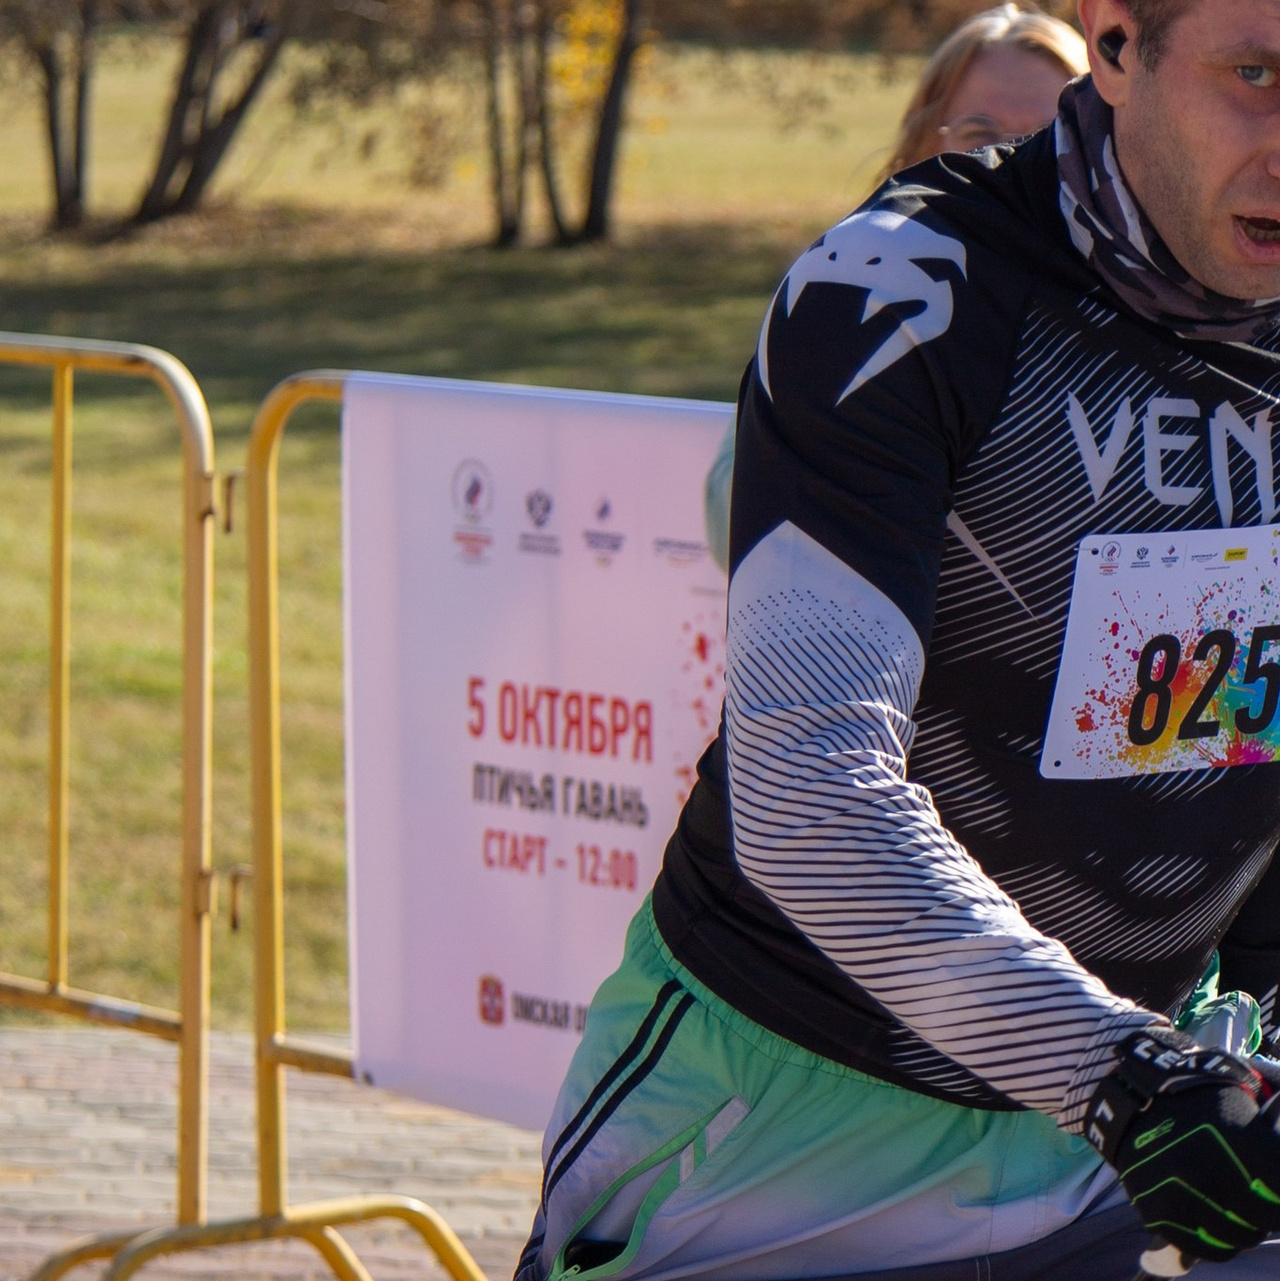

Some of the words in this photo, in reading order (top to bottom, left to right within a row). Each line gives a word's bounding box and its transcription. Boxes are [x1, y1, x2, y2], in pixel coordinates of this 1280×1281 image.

[467, 676, 486, 738] 5
[497, 681, 654, 762] ОКТЯБРЯ
[472, 762, 556, 813] ПТИЧЬЯ
[562, 775, 649, 828] ГАВАНЬ
[483, 828, 548, 875] СТАРТ
[575, 843, 637, 891] 12:00
